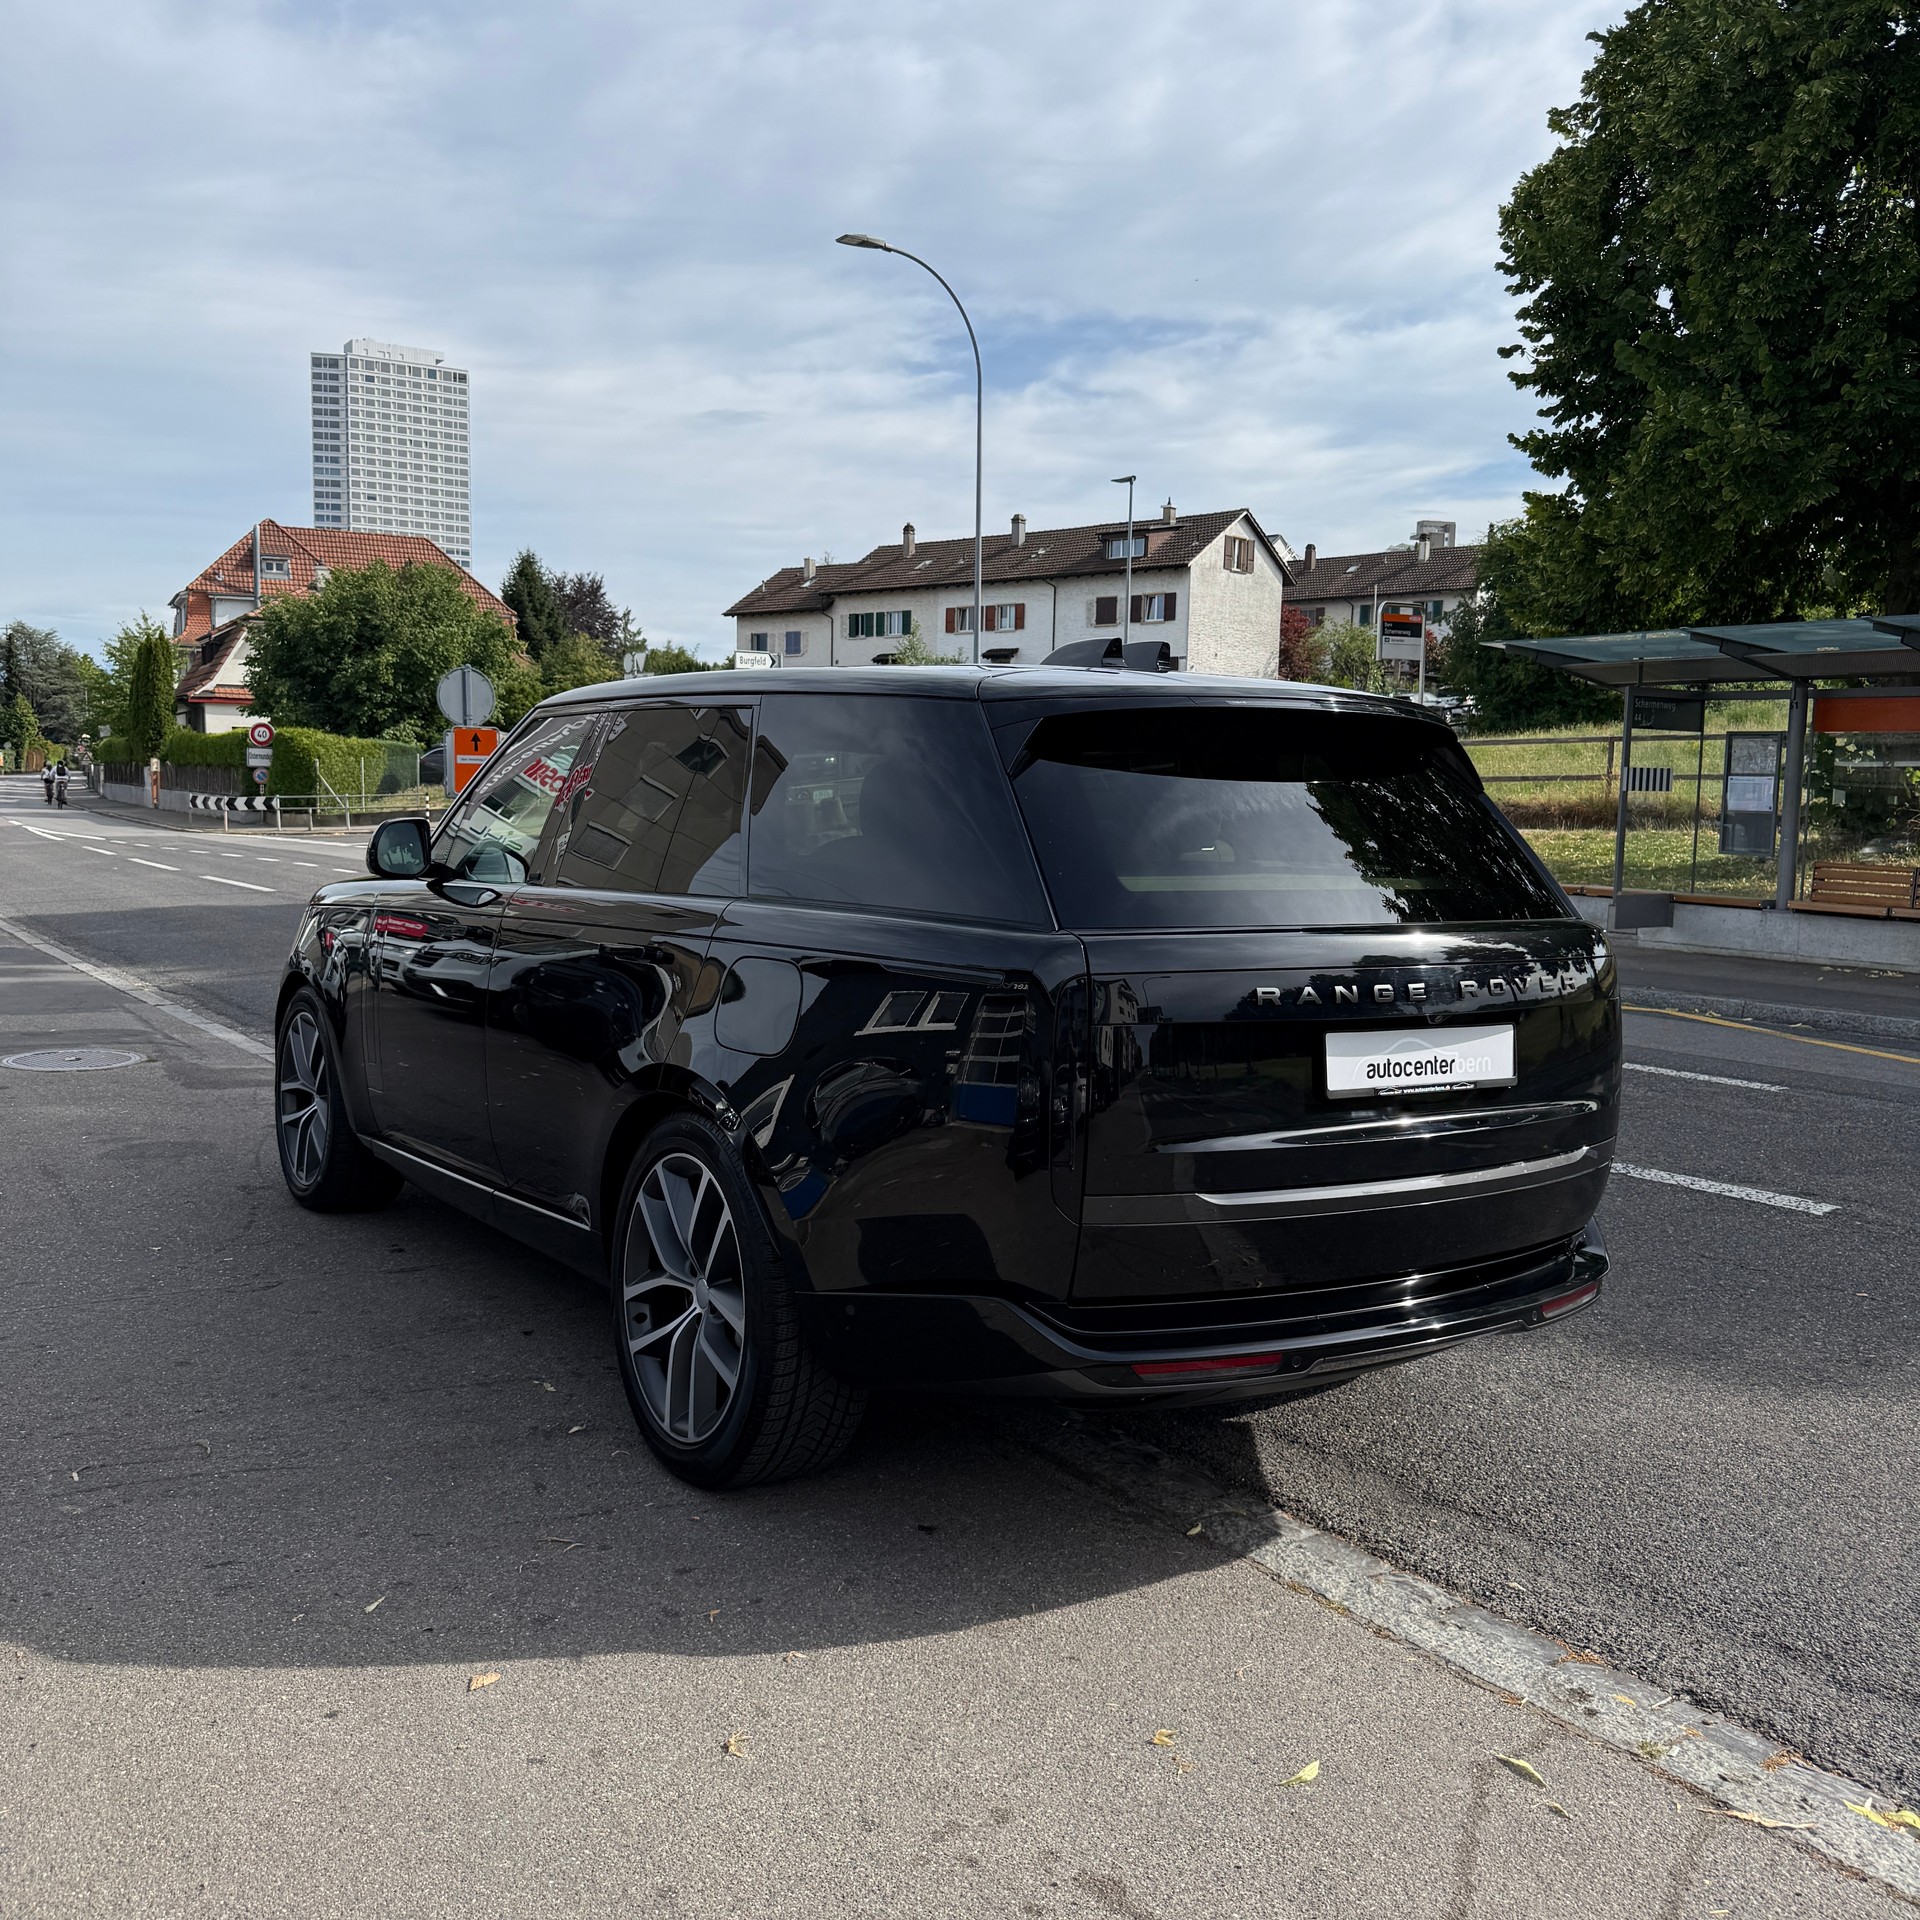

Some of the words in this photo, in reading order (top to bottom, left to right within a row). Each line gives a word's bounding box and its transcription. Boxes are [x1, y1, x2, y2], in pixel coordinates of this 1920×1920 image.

[739, 656, 767, 667] Burgfeld
[1634, 698, 1677, 712] Schermenweg
[257, 730, 268, 739] 40
[1256, 982, 1427, 1006] RANGE
[1458, 974, 1578, 999] ROVER
